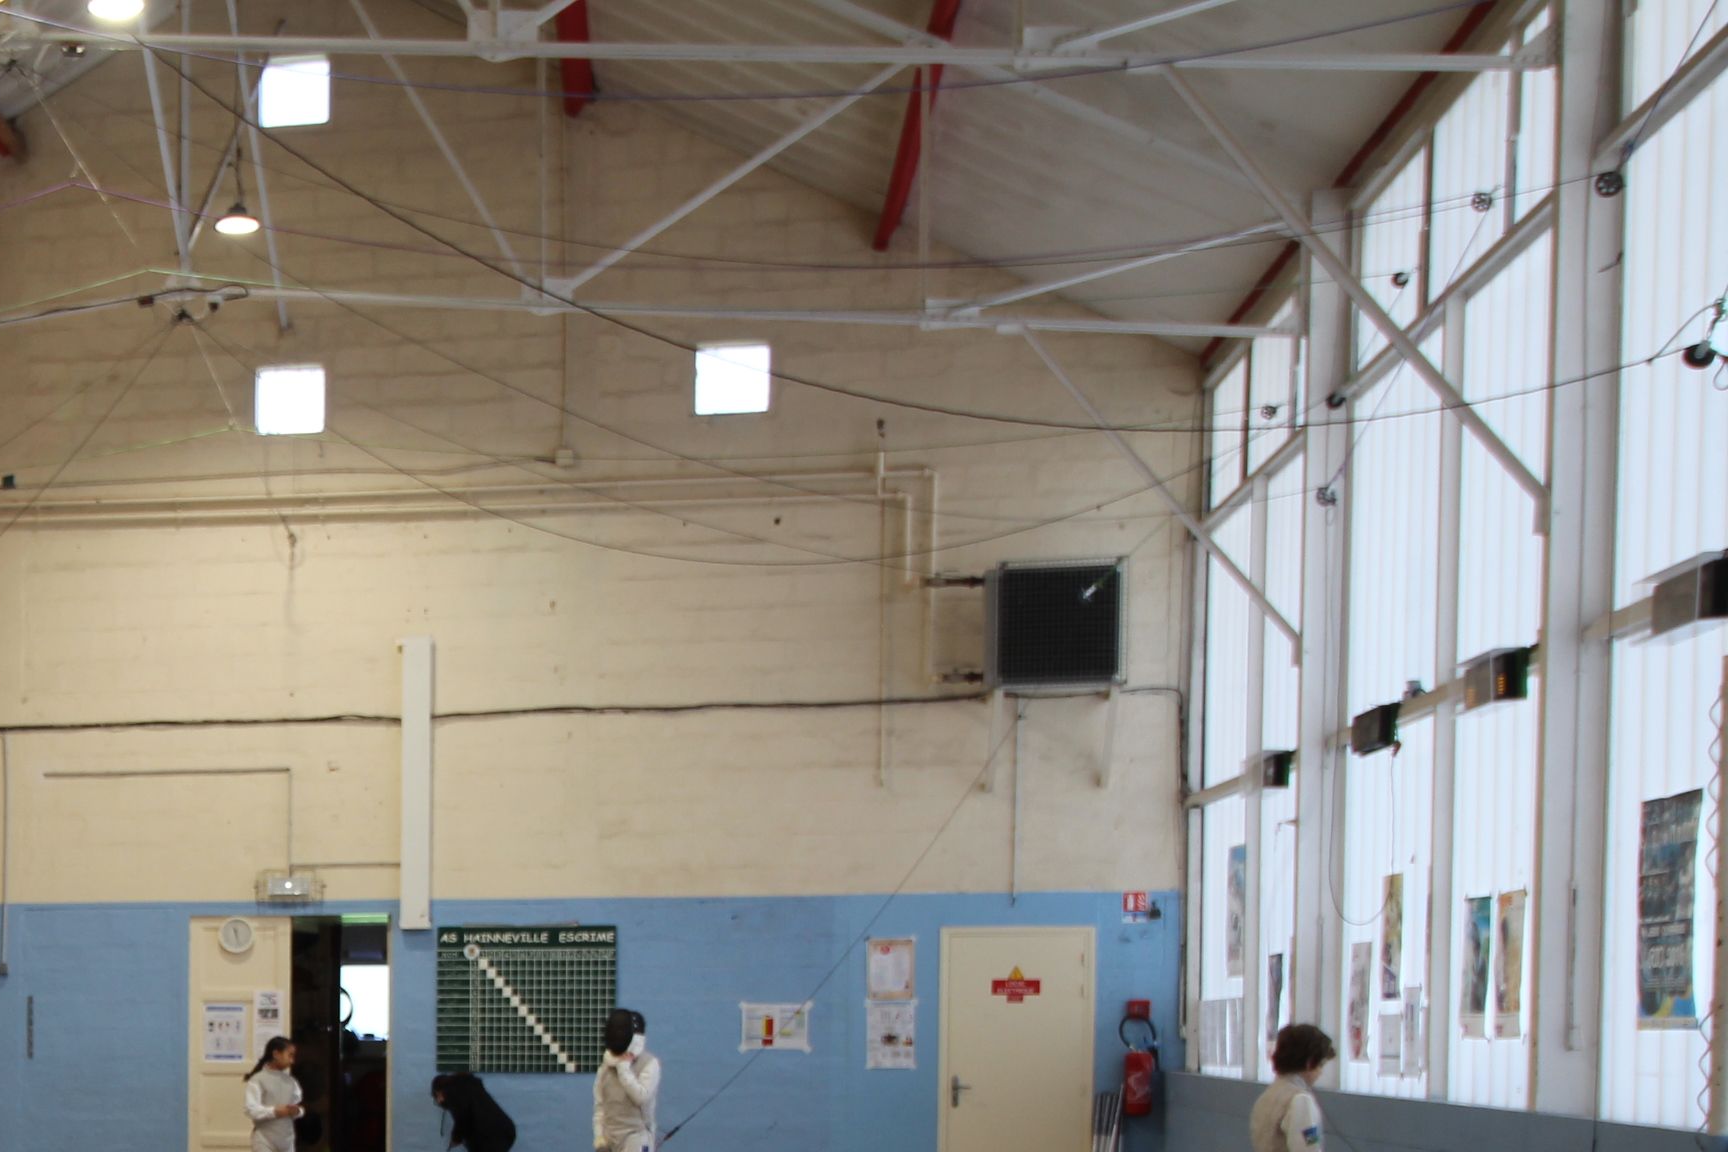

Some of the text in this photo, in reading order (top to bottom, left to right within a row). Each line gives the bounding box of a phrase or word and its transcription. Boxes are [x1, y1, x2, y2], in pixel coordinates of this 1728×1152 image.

[440, 932, 615, 943] AS HAINNEVILLE ESCRIME
